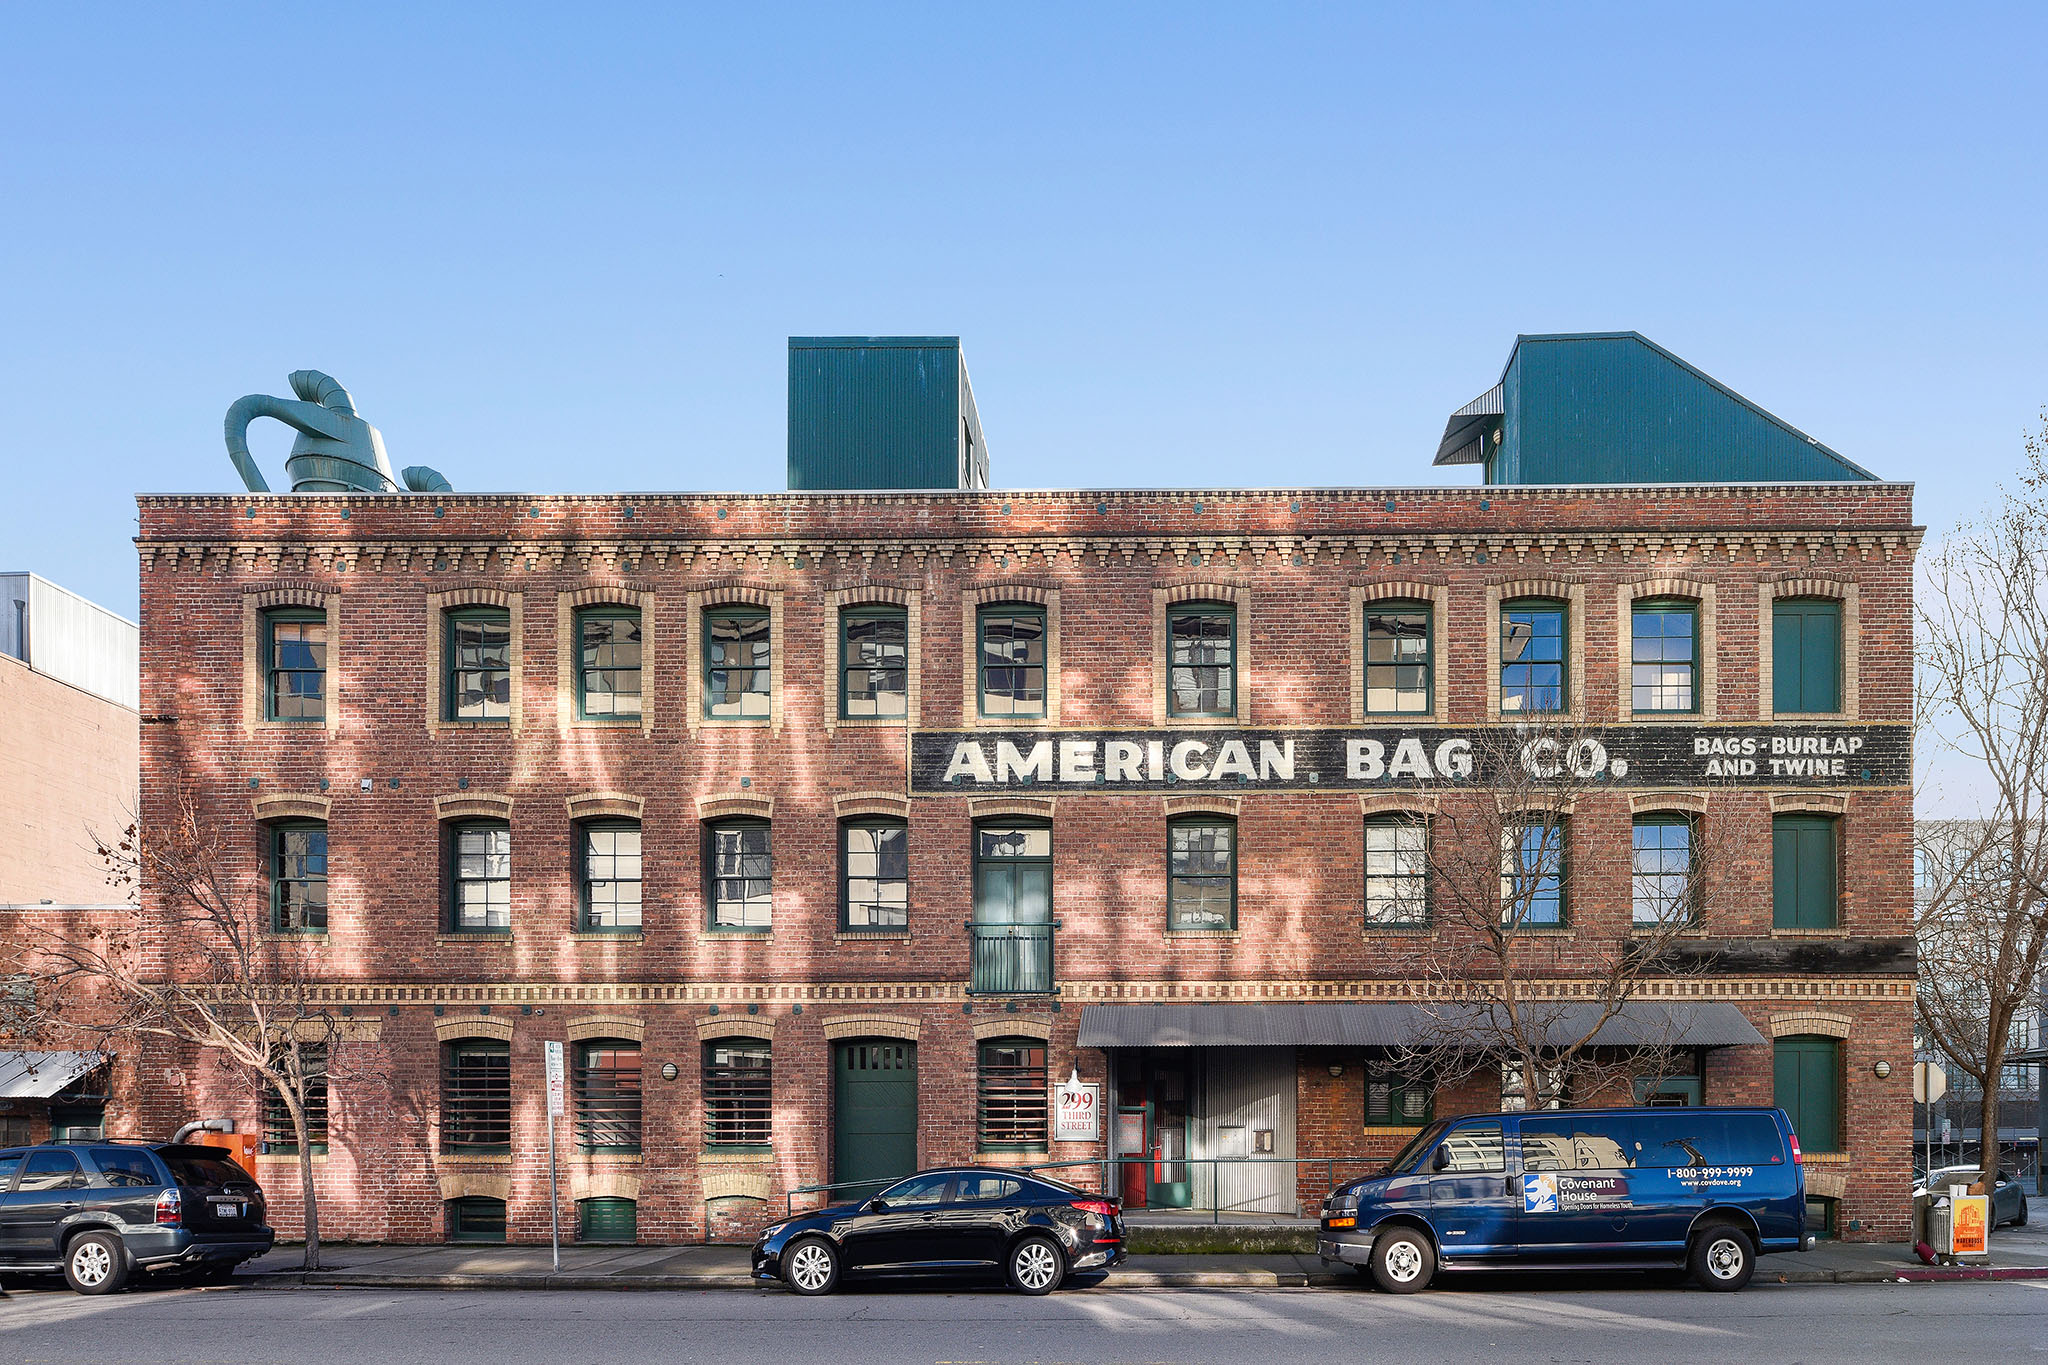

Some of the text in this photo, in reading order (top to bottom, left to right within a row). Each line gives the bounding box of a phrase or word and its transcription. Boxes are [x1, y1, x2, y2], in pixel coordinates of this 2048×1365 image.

[943, 738, 1629, 781] AMERICAN BAG CO.
[1705, 758, 1847, 777] AND TWINE
[1062, 1092, 1093, 1110] 299
[1063, 1111, 1092, 1120] THIRD
[1061, 1121, 1093, 1130] STREET
[1667, 1166, 1754, 1180] 1-800-999-9999
[1559, 1178, 1616, 1190] Covenant
[1680, 1179, 1742, 1188] www.covdove.org
[1561, 1190, 1598, 1202] House
[1561, 1202, 1580, 1211] Opening
